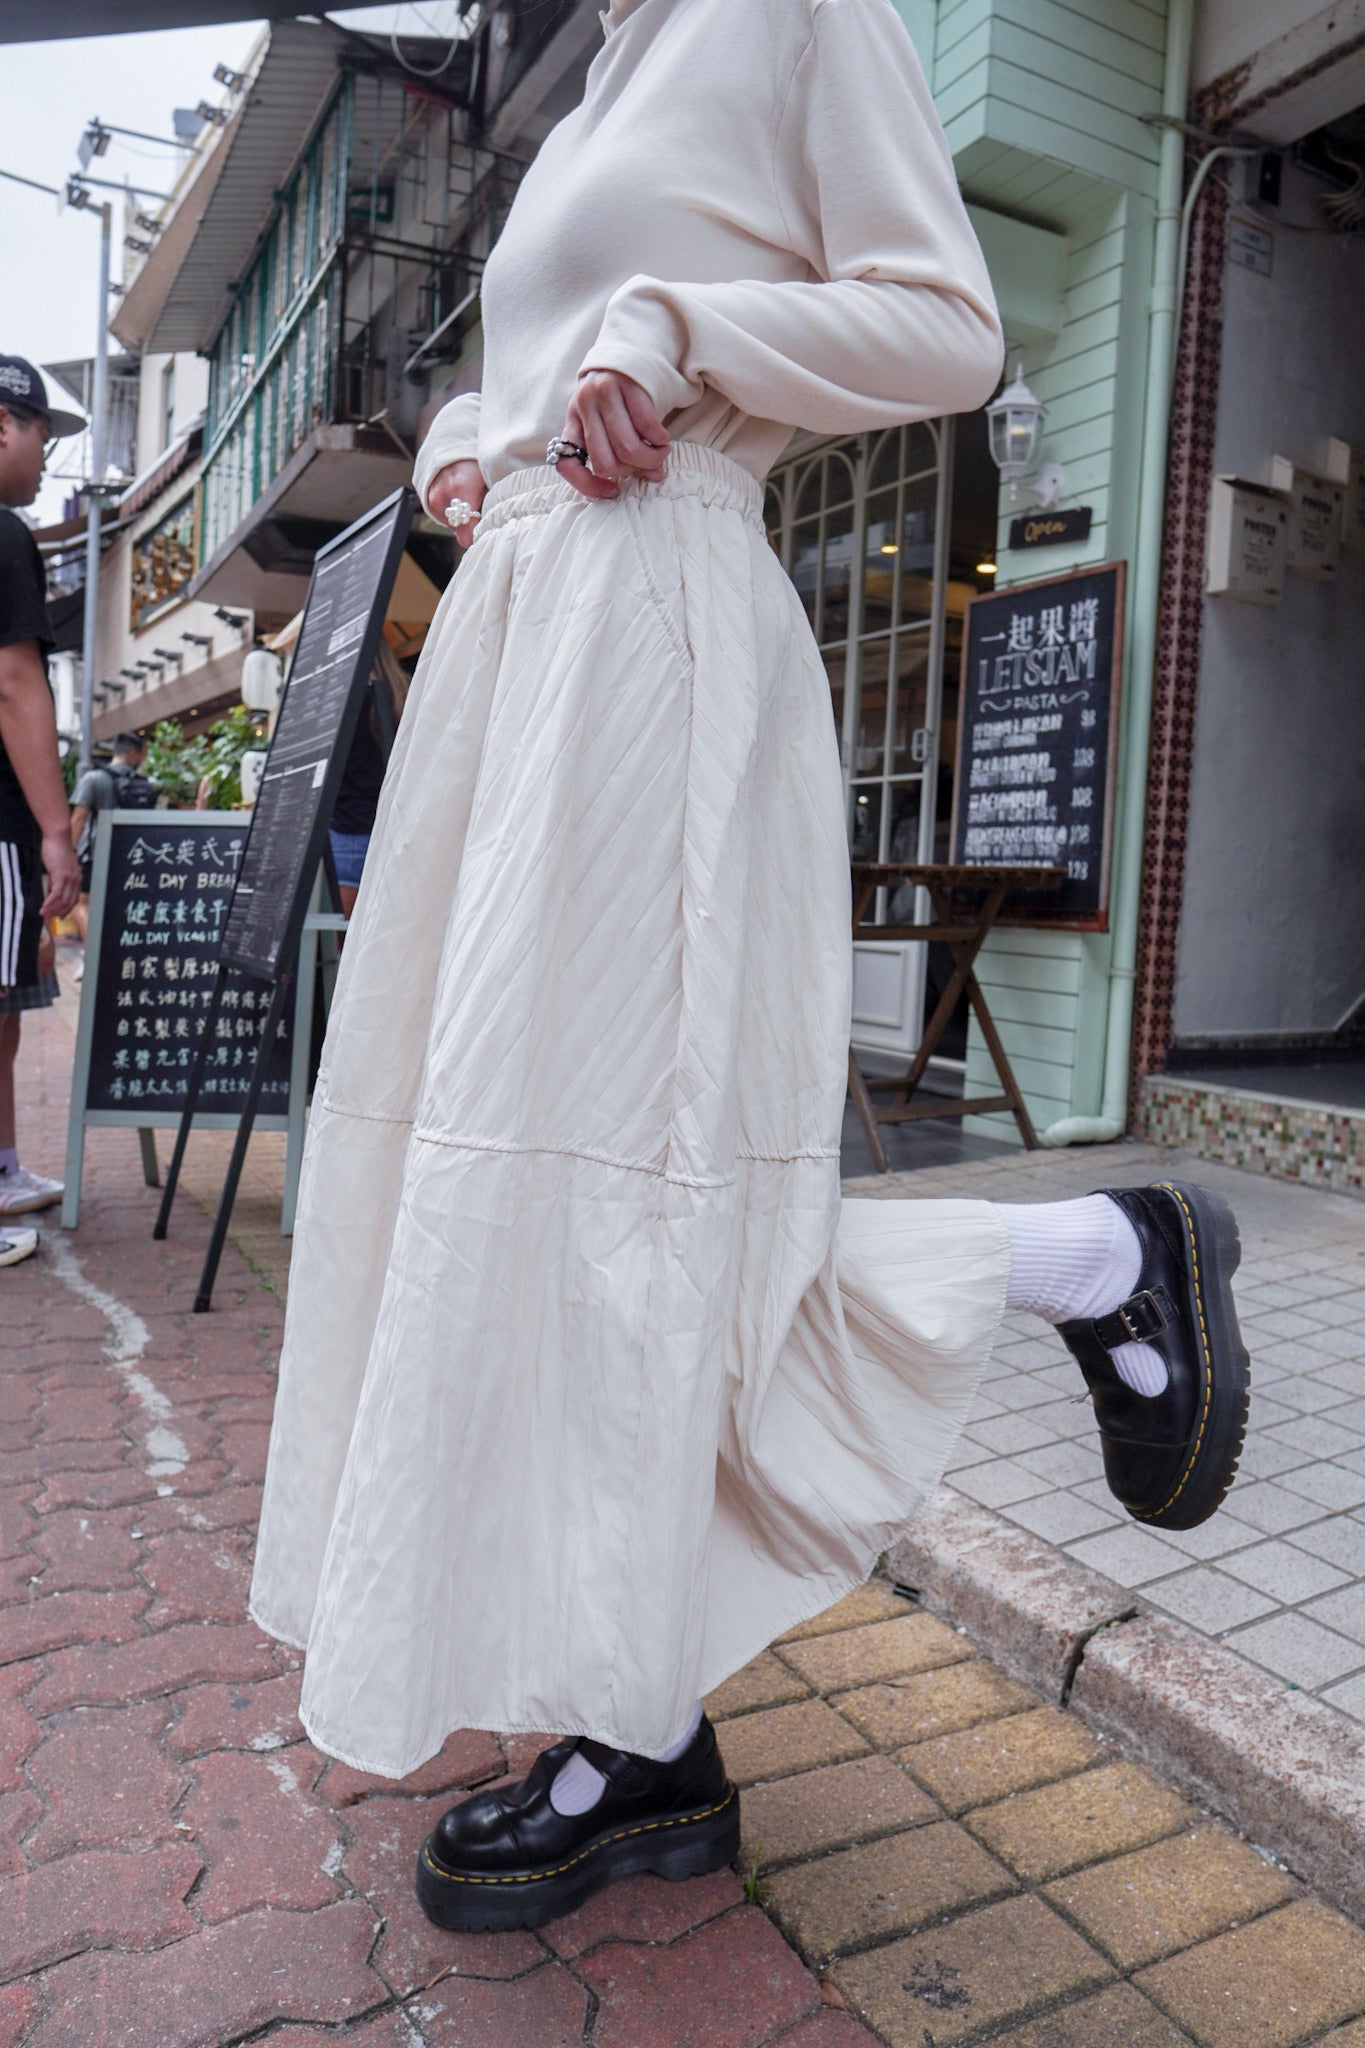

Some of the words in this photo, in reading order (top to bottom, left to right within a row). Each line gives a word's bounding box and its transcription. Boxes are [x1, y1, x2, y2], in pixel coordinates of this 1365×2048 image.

[980, 597, 1099, 653] 一起果醬
[1013, 693, 1059, 710] PASTA
[123, 872, 149, 891] ALL
[158, 872, 188, 891] DAY
[119, 930, 144, 946] ALL
[145, 931, 171, 946] DAY
